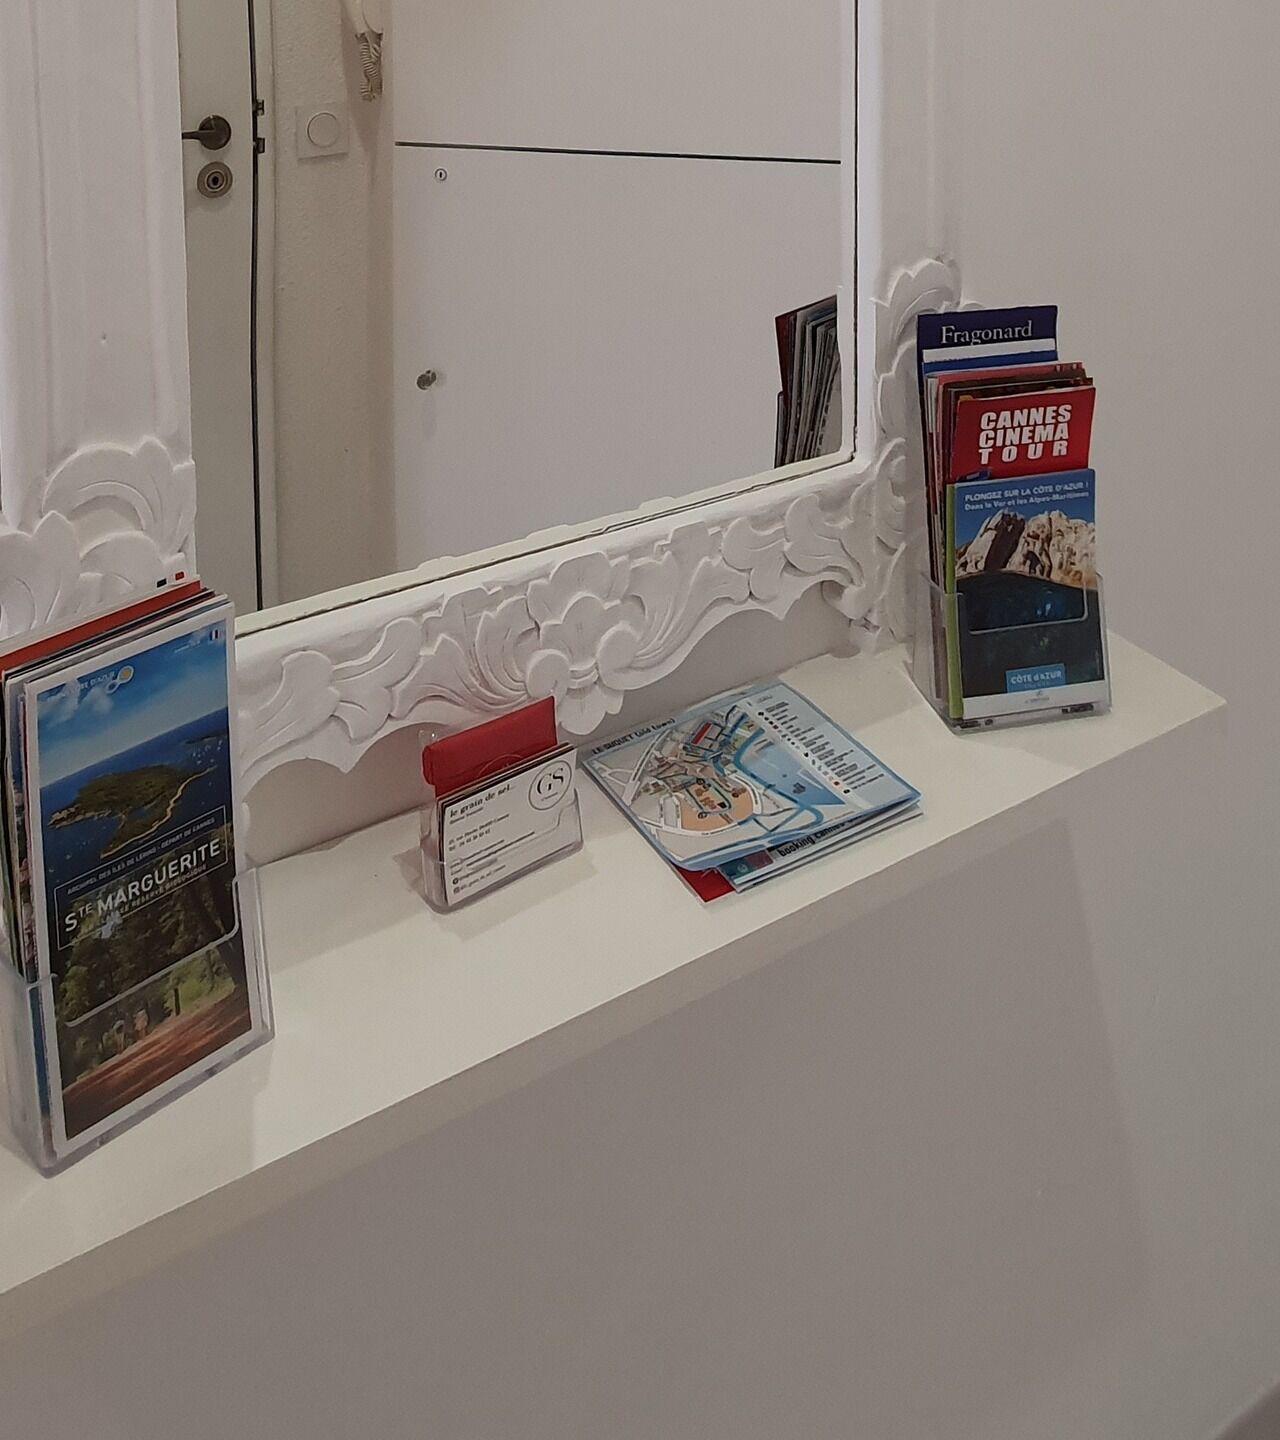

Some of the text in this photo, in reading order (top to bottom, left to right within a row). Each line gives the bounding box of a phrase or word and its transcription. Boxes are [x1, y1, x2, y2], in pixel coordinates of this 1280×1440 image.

[940, 320, 1033, 346] Fragonard
[980, 404, 1072, 430] CANNES
[978, 423, 1069, 448] CINEMA
[978, 440, 1068, 465] TOUR
[964, 490, 1002, 502] PLONGEZ
[1004, 489, 1020, 498] SUR
[1021, 488, 1031, 496] LA
[1010, 672, 1032, 685] CÔTE
[536, 767, 564, 795] GS
[460, 799, 483, 814] grain
[484, 791, 496, 802] de
[776, 834, 816, 858] booking
[97, 838, 221, 917] MARGUERITE
